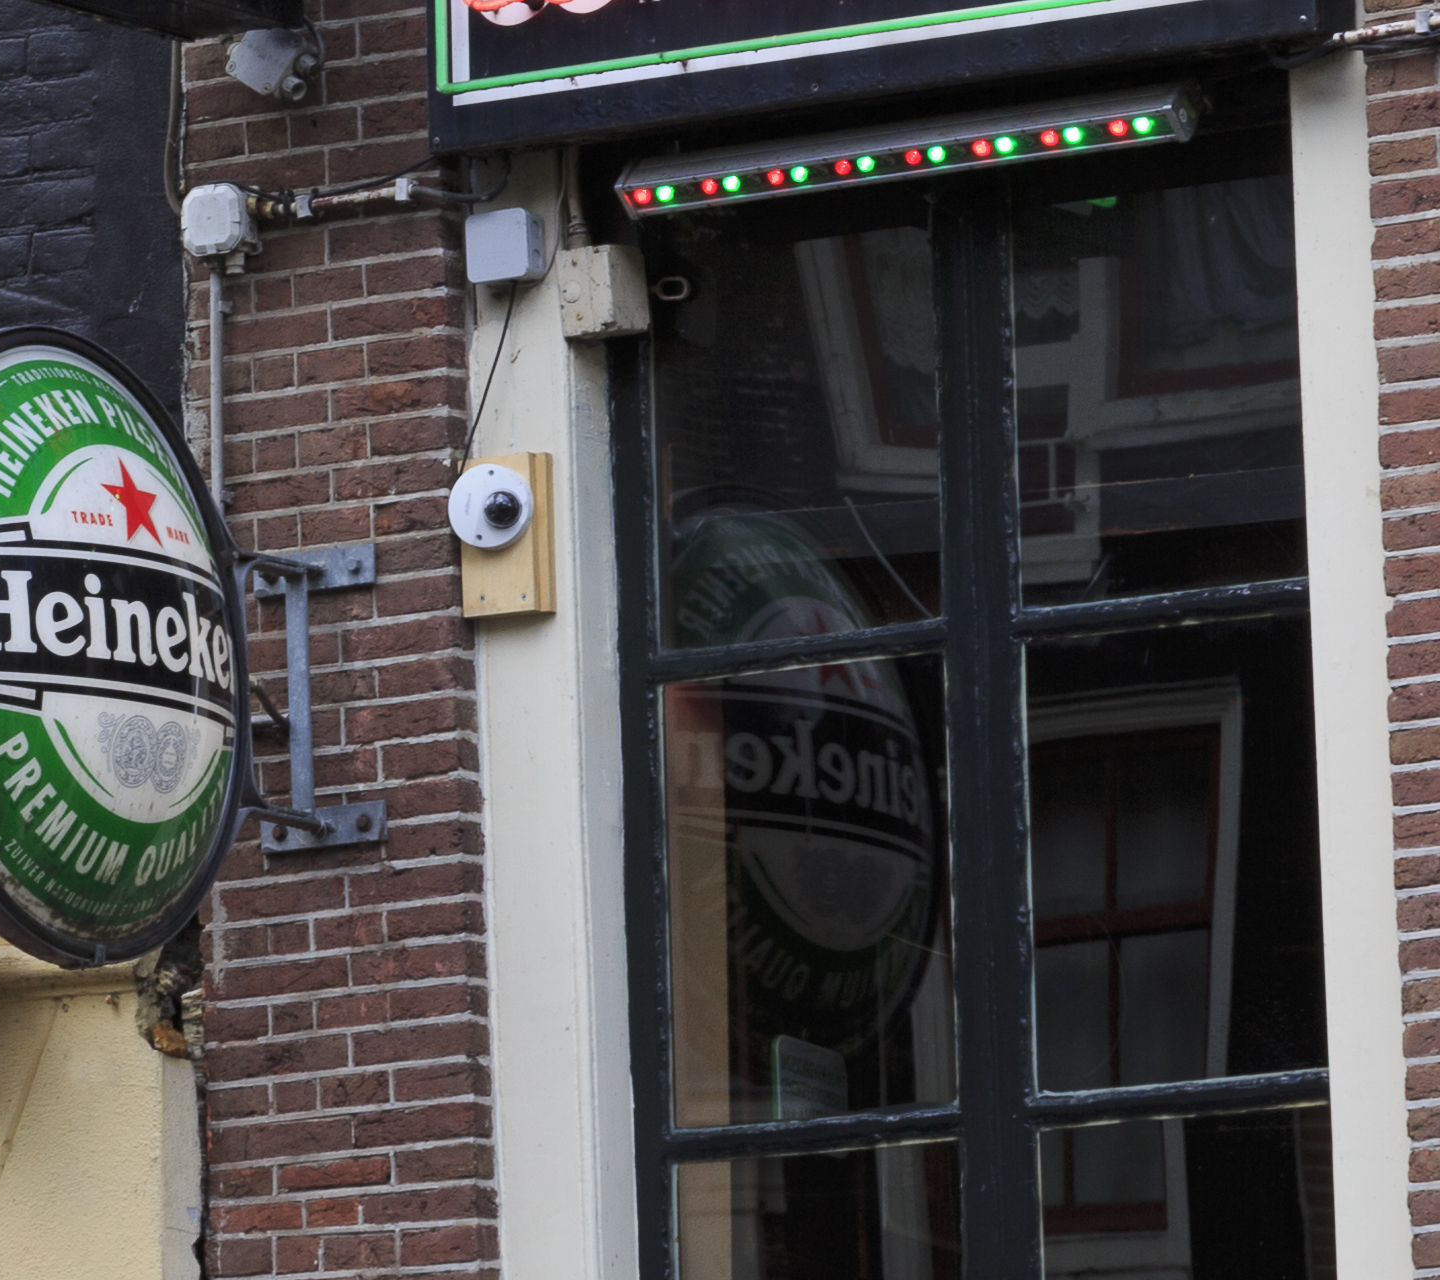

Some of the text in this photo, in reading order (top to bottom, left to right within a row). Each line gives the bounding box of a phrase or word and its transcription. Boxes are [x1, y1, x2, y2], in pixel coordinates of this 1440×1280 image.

[71, 510, 190, 544] TRADE MARK
[4, 838, 46, 884] ZUIVER
